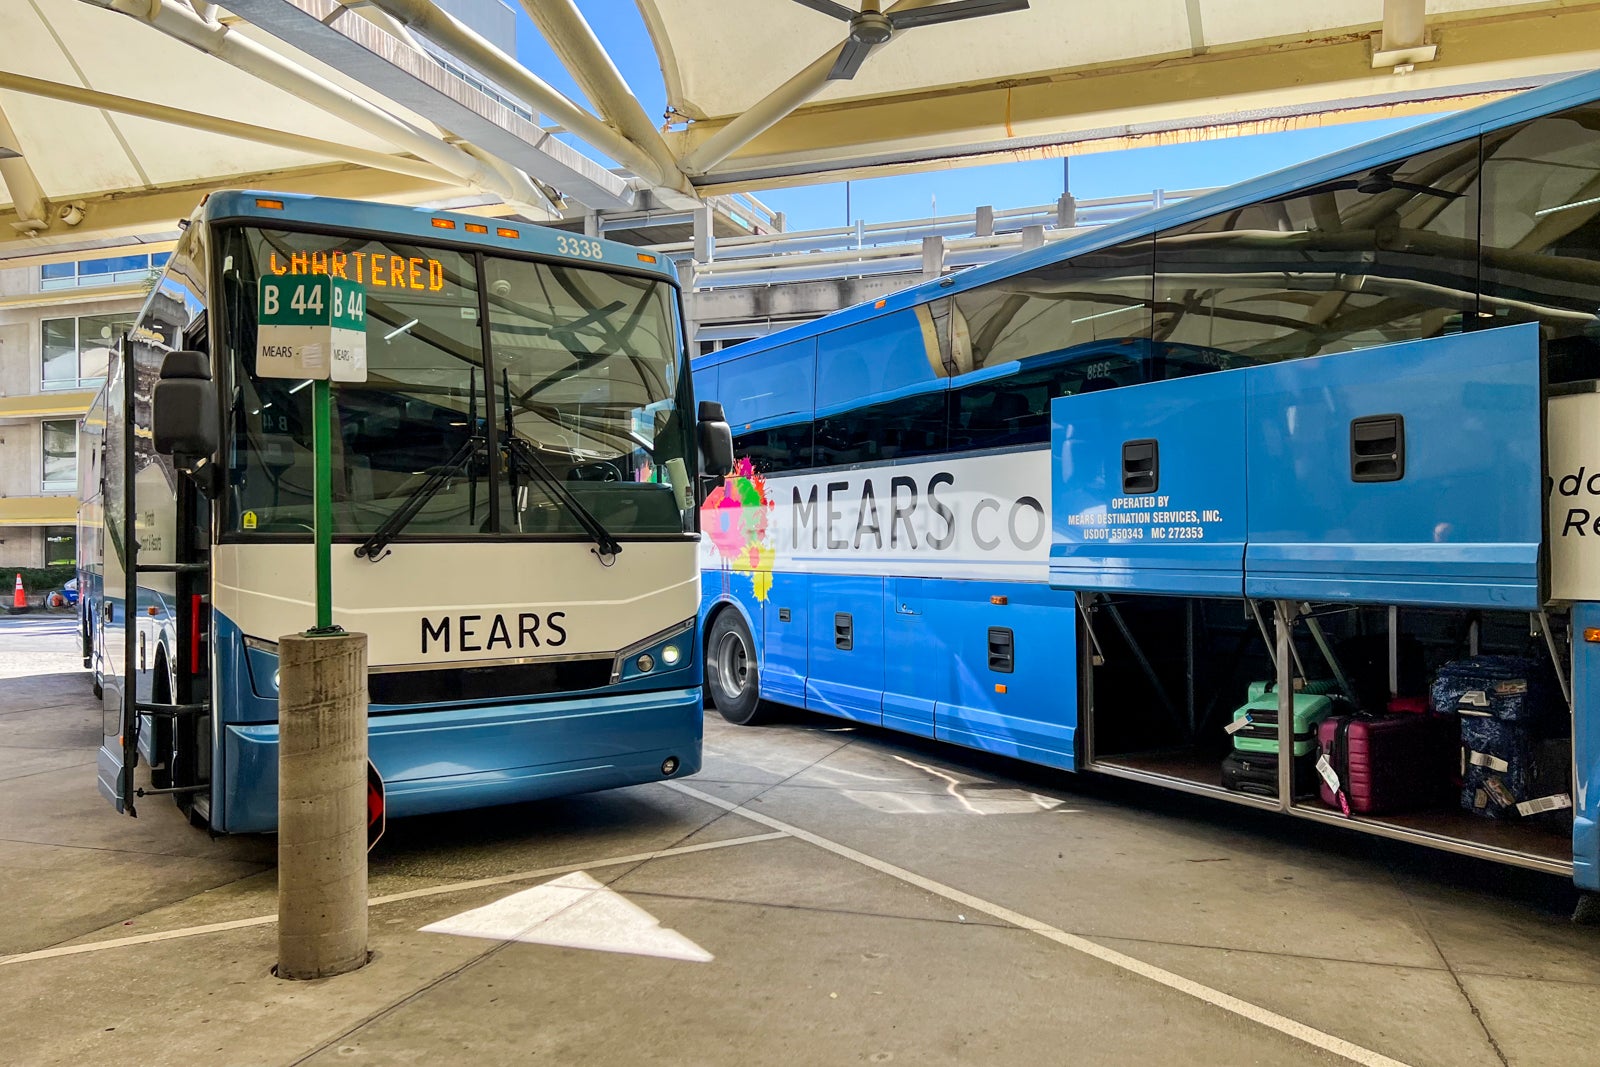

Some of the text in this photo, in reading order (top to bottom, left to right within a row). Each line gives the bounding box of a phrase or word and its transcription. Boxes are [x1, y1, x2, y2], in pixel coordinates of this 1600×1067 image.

[557, 235, 603, 260] 3338
[269, 249, 443, 292] CHARTERED
[264, 284, 324, 315] B 44
[334, 286, 364, 322] B 44
[262, 345, 293, 358] MEARS
[792, 471, 956, 550] MEARS
[1112, 496, 1169, 509] OPERATED BY
[1068, 510, 1223, 526] MEARS DESTINATION SERVICES, INC.
[1083, 526, 1204, 540] USDOT 550343 MC 272353
[421, 611, 567, 654] MEARS
